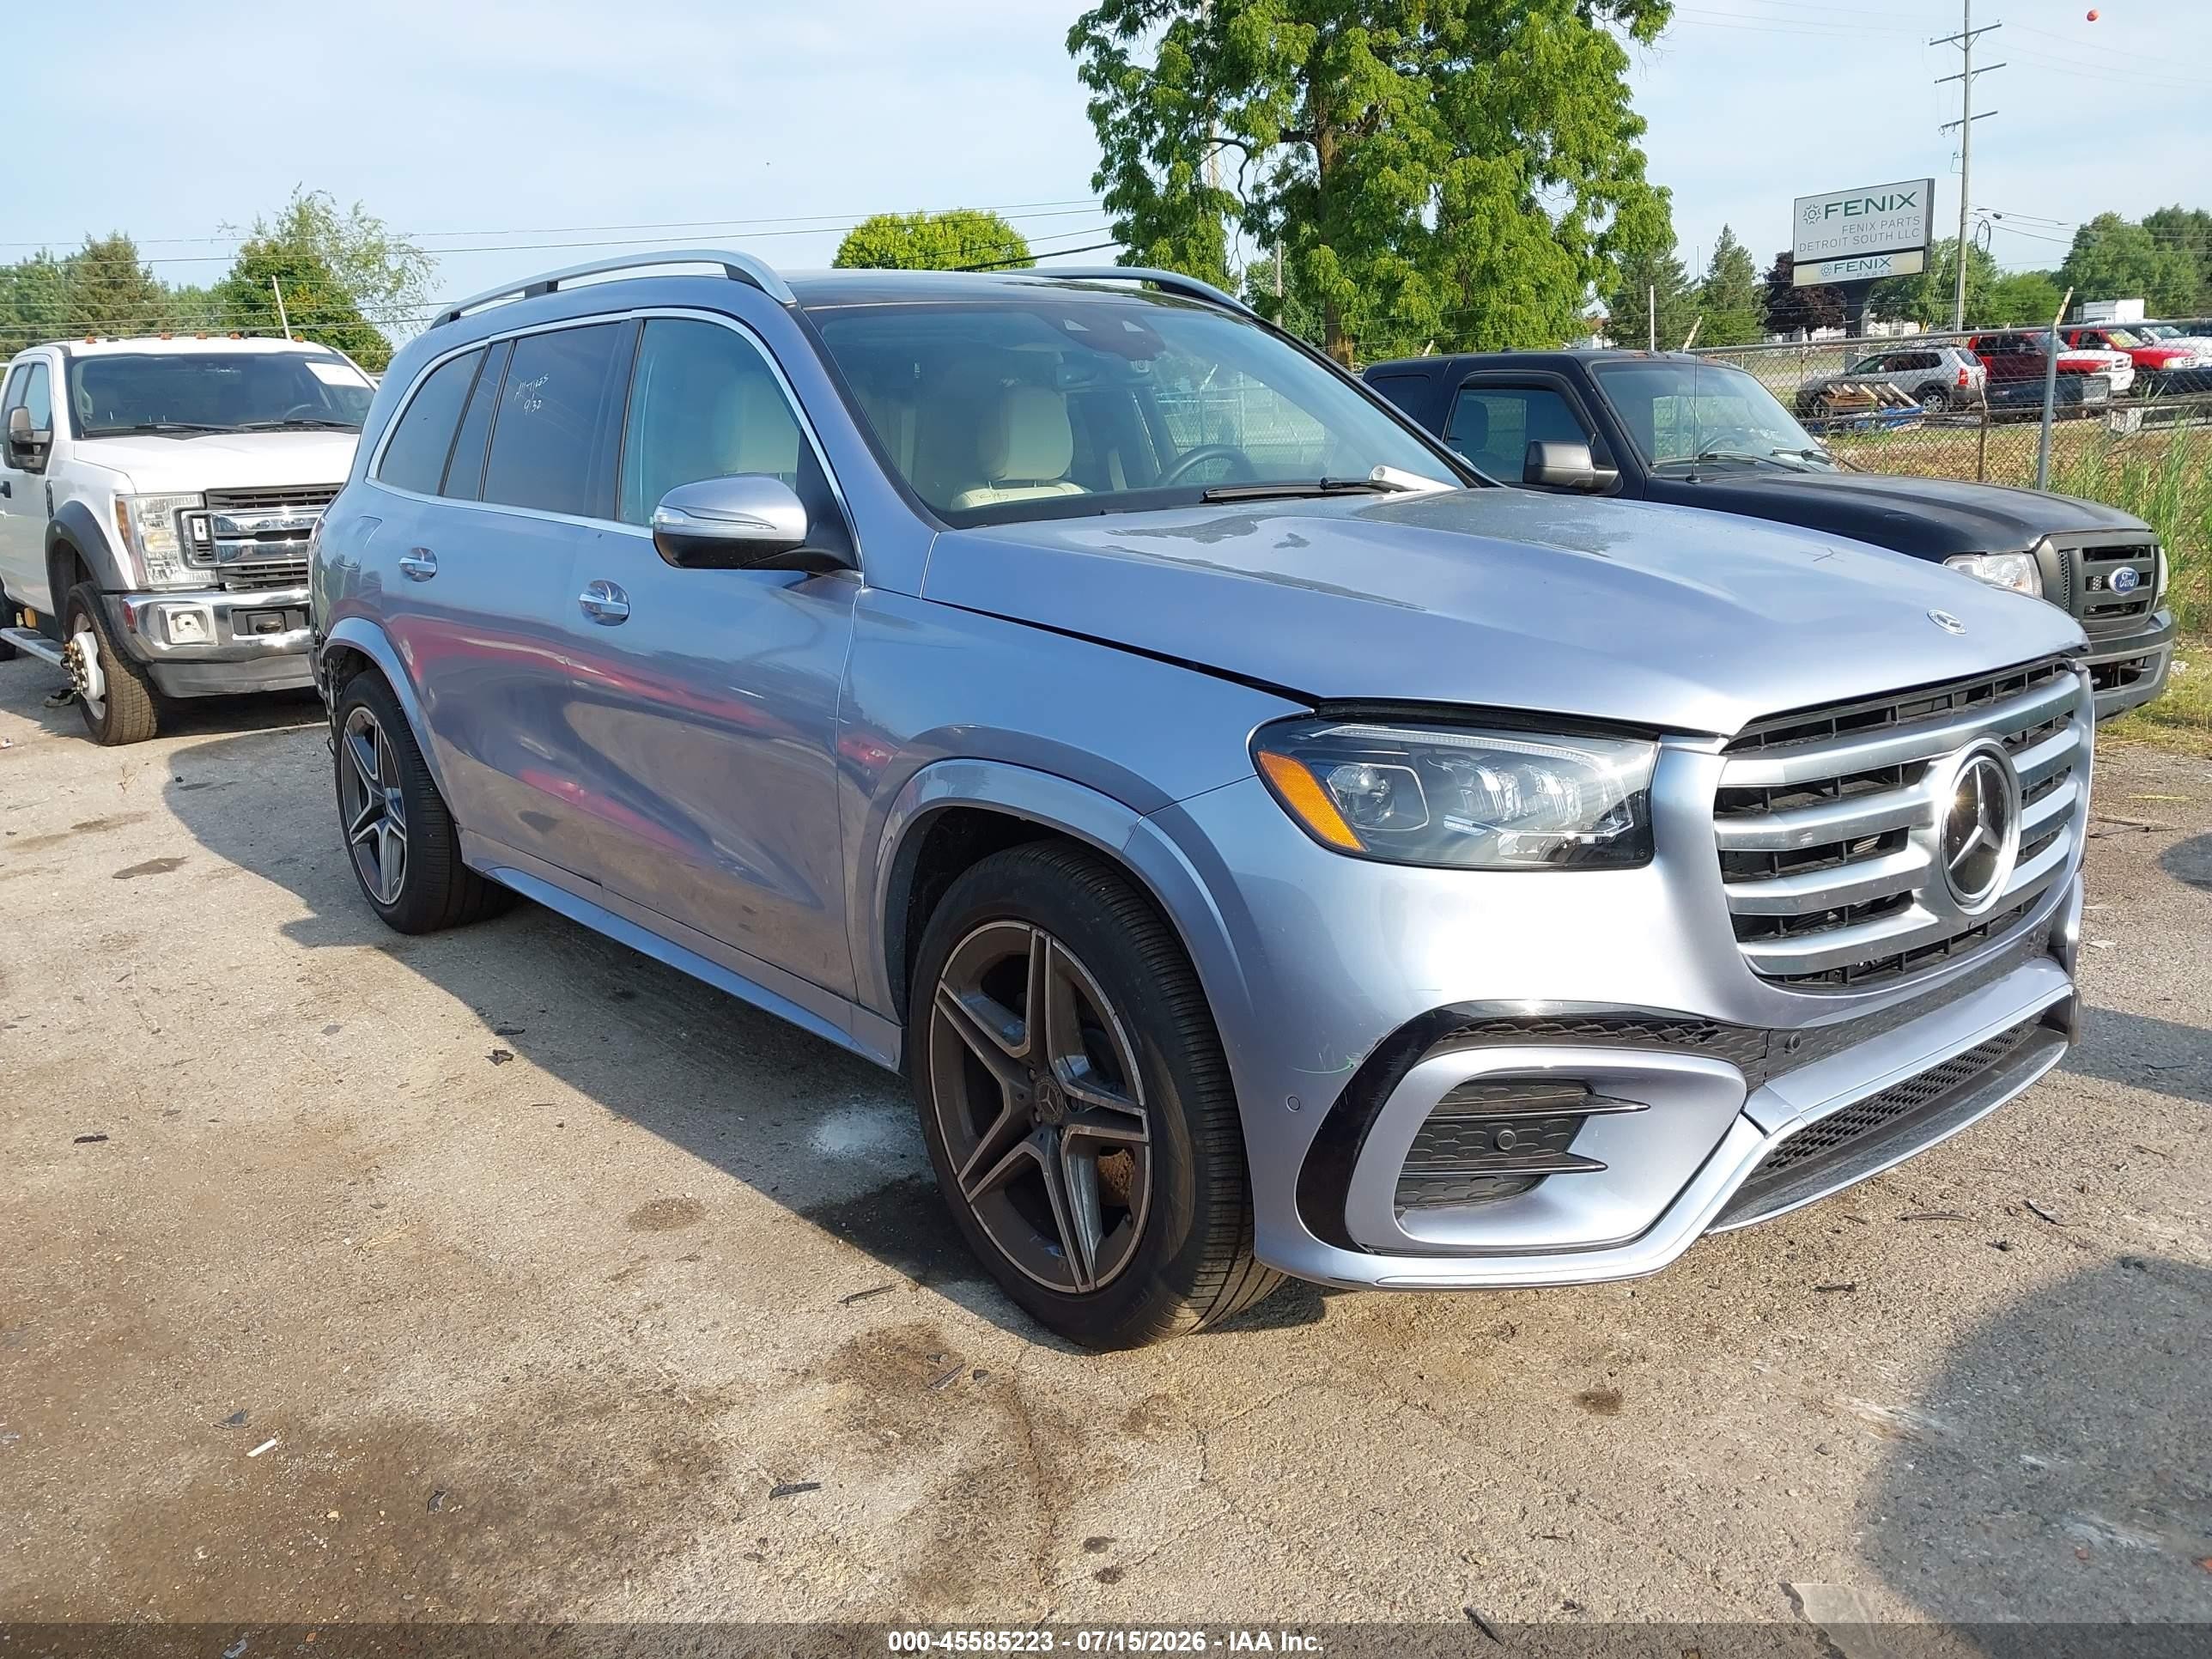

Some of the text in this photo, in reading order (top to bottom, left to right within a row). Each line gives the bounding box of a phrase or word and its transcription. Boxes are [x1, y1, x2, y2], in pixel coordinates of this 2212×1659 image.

[1825, 191, 1917, 220] FENIX
[1842, 216, 1920, 234] FENIX PARTS
[1799, 228, 1920, 252] DETROIT SOUTH LLC
[1833, 256, 1893, 274] FENIX
[1856, 269, 1893, 278] PARTS
